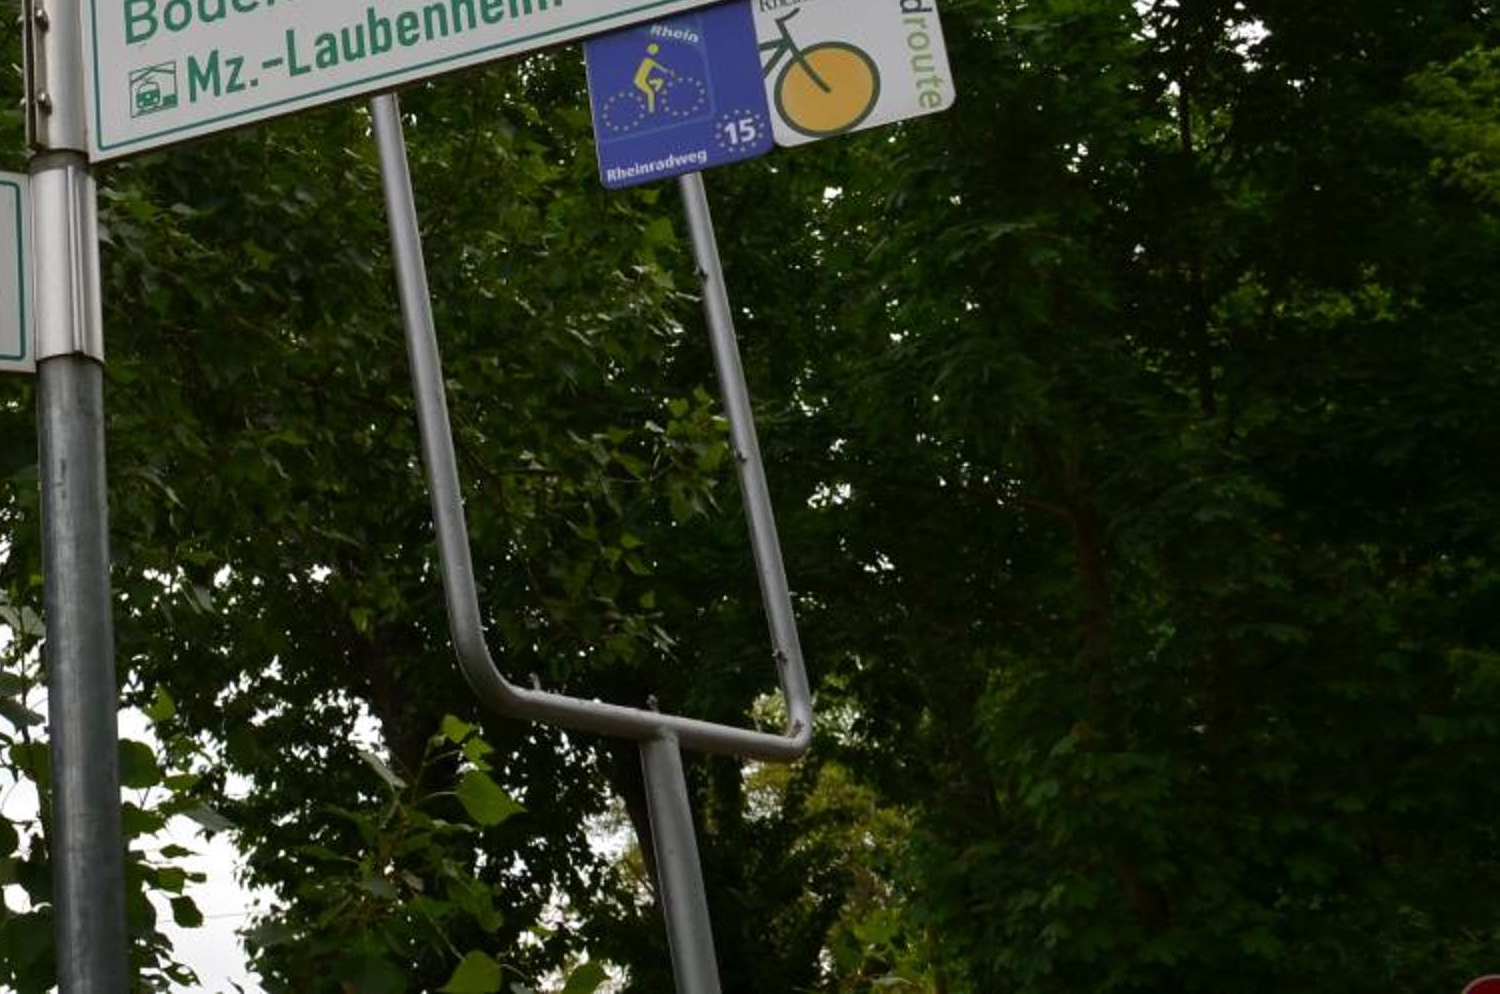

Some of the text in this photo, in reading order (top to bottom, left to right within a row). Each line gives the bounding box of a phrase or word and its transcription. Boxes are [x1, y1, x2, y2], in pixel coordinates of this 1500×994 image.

[649, 23, 700, 44] Rhein
[724, 117, 759, 145] 15
[607, 150, 708, 183] Rheinradweg
